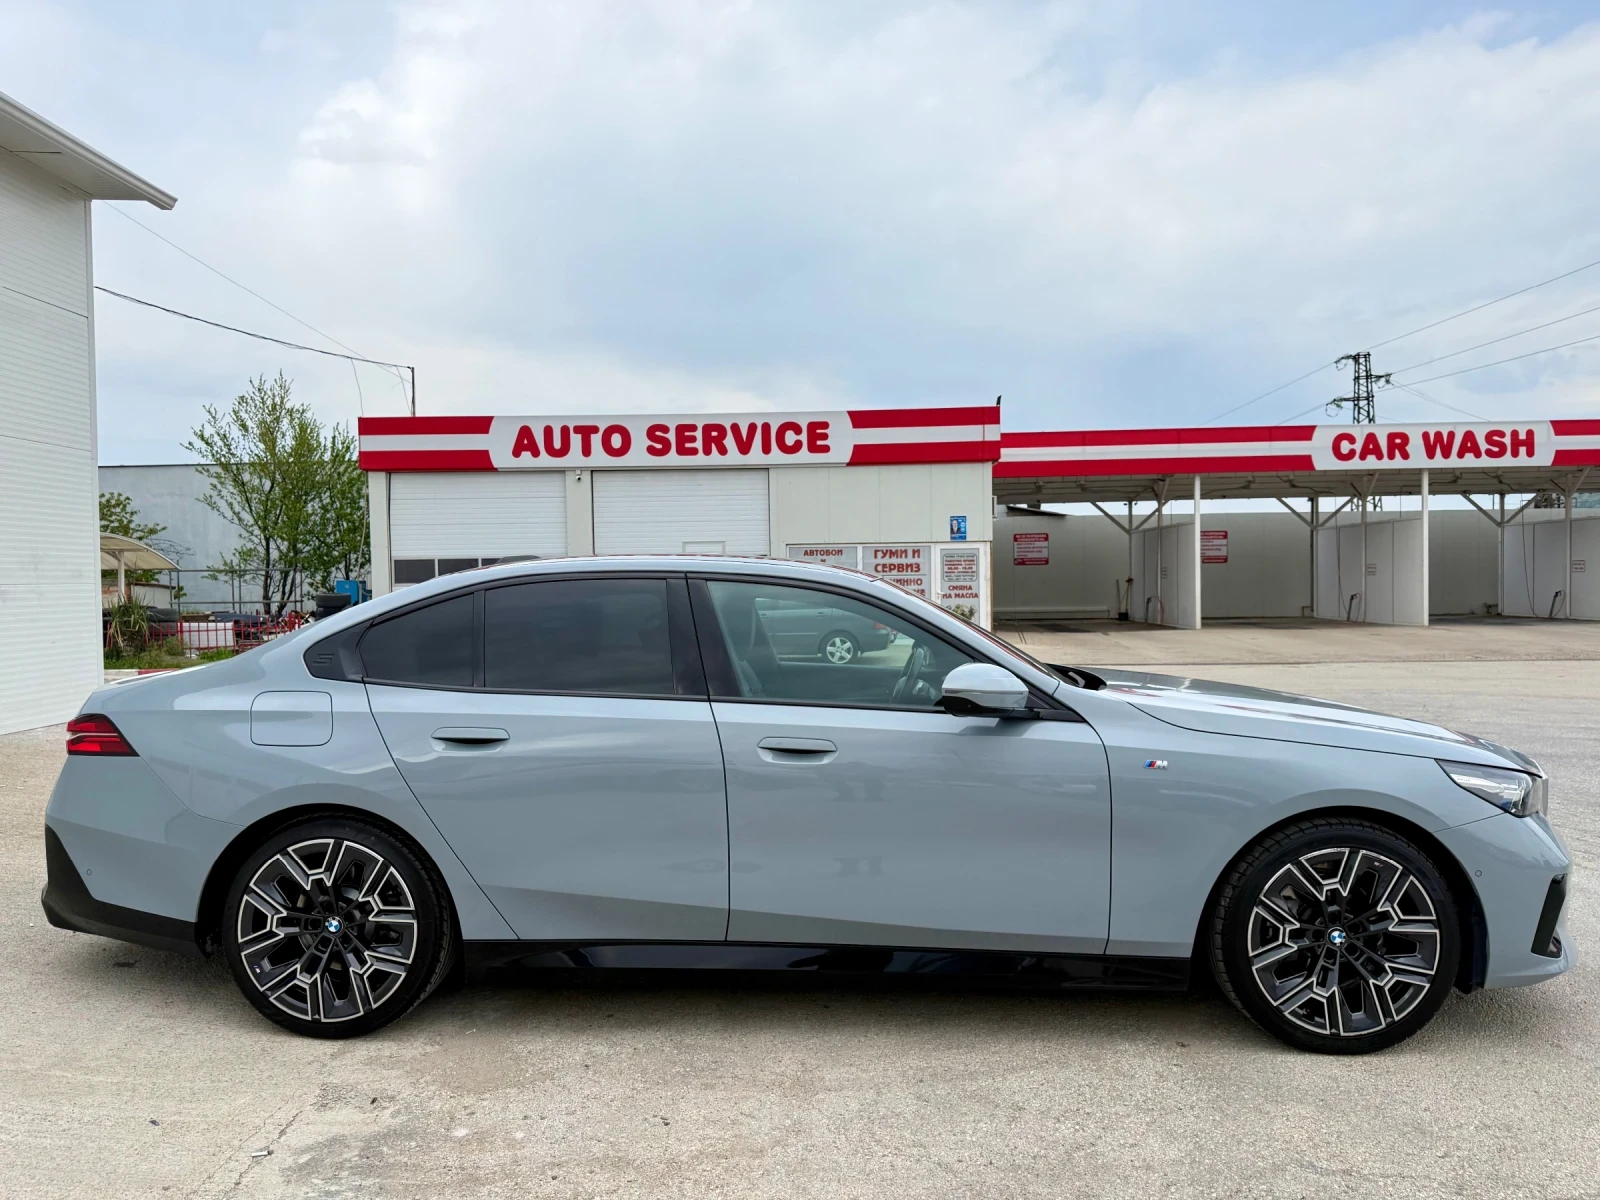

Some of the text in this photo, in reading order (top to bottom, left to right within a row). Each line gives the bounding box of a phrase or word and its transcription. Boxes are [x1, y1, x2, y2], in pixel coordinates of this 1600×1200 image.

[511, 421, 831, 458] AUTO SERVICE
[1331, 428, 1535, 462] CAR WASH
[803, 549, 843, 557] АВТОБОИ
[873, 548, 921, 559] ГУМИ И
[874, 562, 921, 573] СЕРВИЗ
